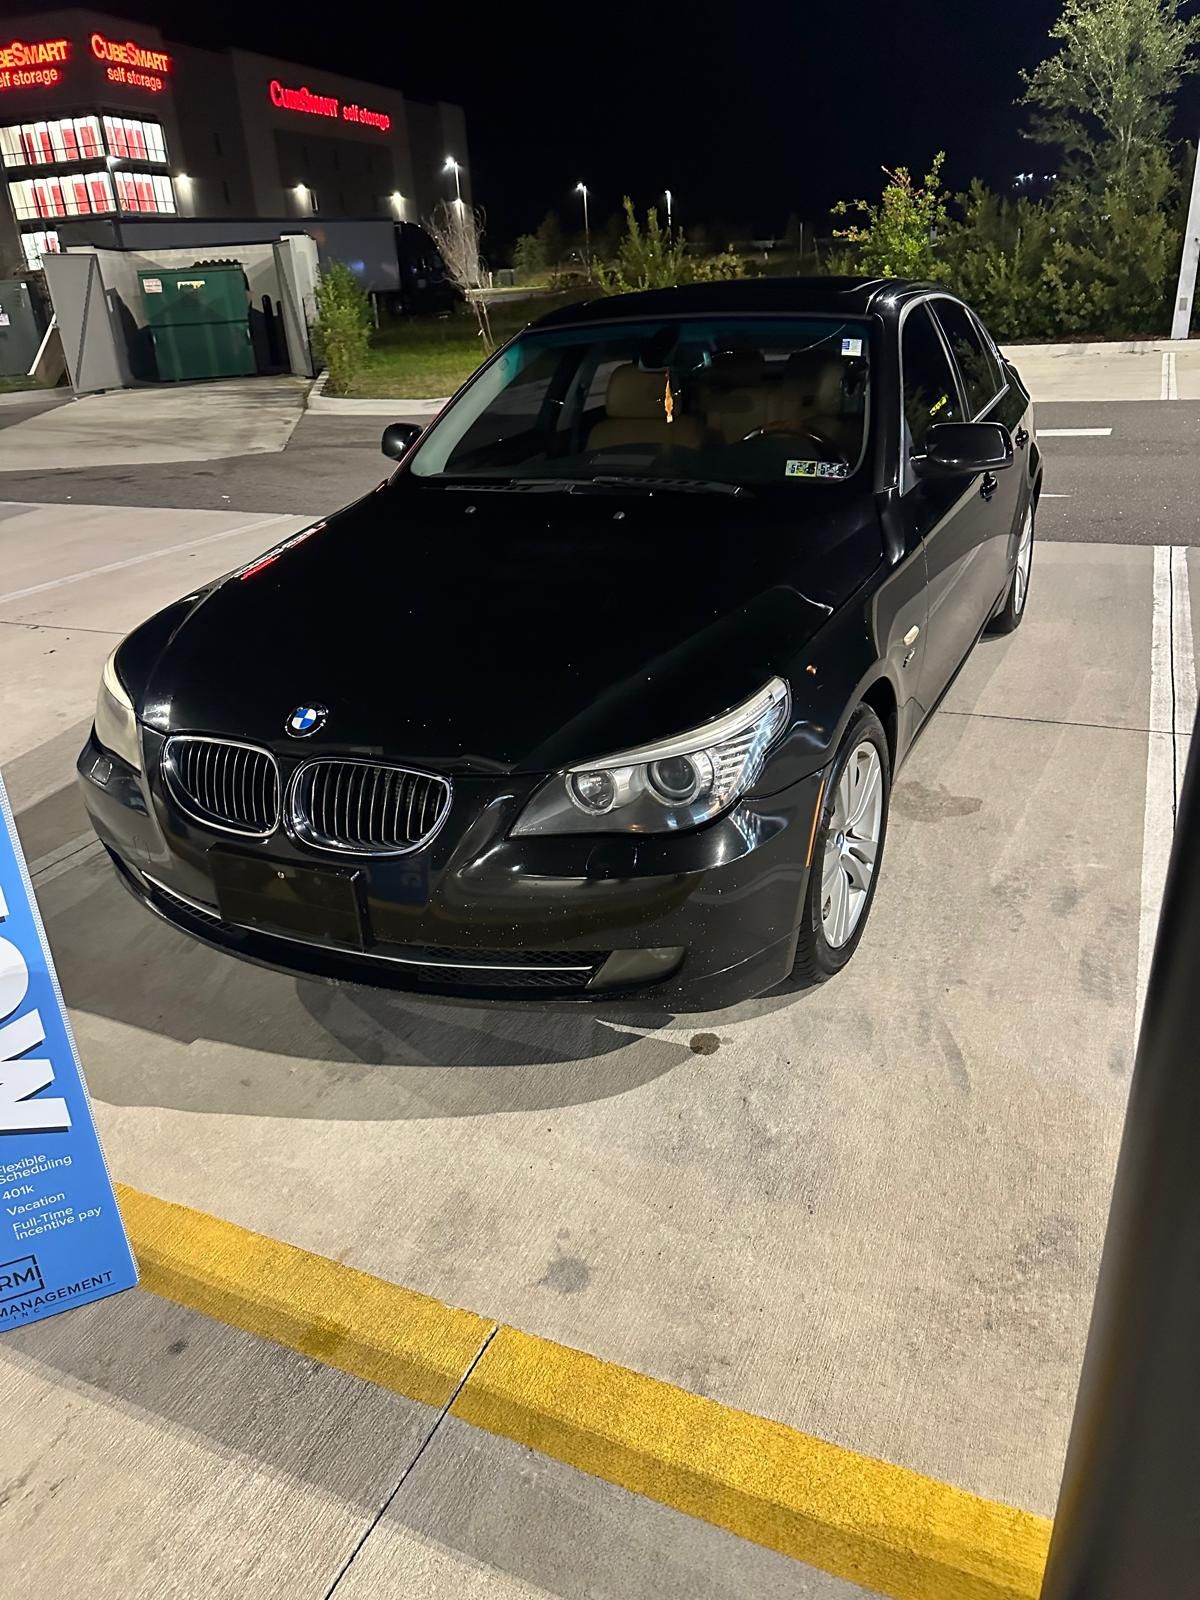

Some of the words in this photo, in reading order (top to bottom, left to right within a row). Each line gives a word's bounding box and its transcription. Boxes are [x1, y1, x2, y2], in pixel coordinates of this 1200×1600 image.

[13, 69, 58, 85] storage
[107, 66, 126, 83] self
[127, 70, 162, 91] storage
[343, 104, 359, 122] self
[360, 107, 390, 131] storage
[0, 1154, 47, 1174] lexible
[0, 1155, 72, 1185] Scheduling
[2, 1184, 35, 1200] 401k
[6, 1192, 65, 1216] Vacation
[12, 1207, 73, 1232] Full-Time
[78, 1206, 102, 1222] pay
[0, 1270, 113, 1318] MANAGEMENT
